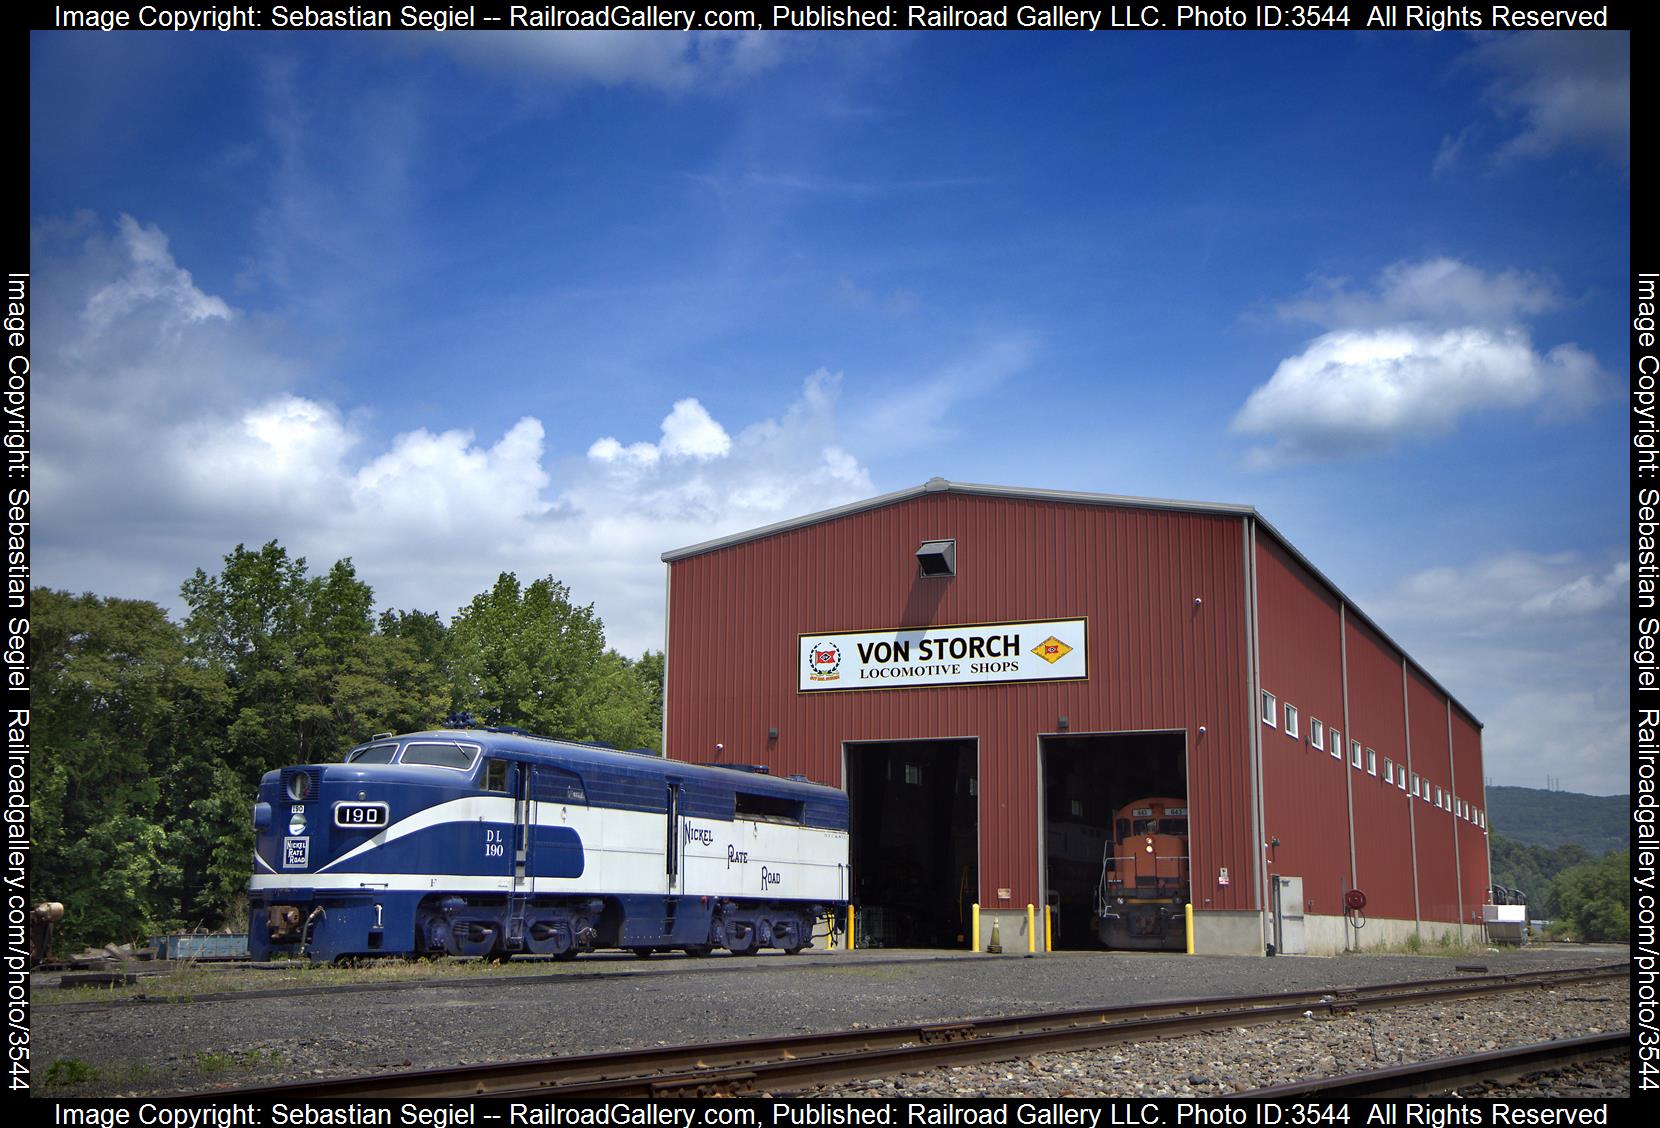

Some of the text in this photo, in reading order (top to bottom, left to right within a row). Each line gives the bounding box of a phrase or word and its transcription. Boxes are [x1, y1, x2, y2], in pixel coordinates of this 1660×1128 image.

[857, 634, 1020, 664] VON STORCH
[860, 661, 1019, 679] LOCOMOTIVE SHOPS
[346, 808, 377, 822] 190
[684, 820, 713, 846] NICKEL
[485, 843, 504, 857] 190
[727, 844, 748, 869] PLATE
[761, 865, 781, 890] ROAD
